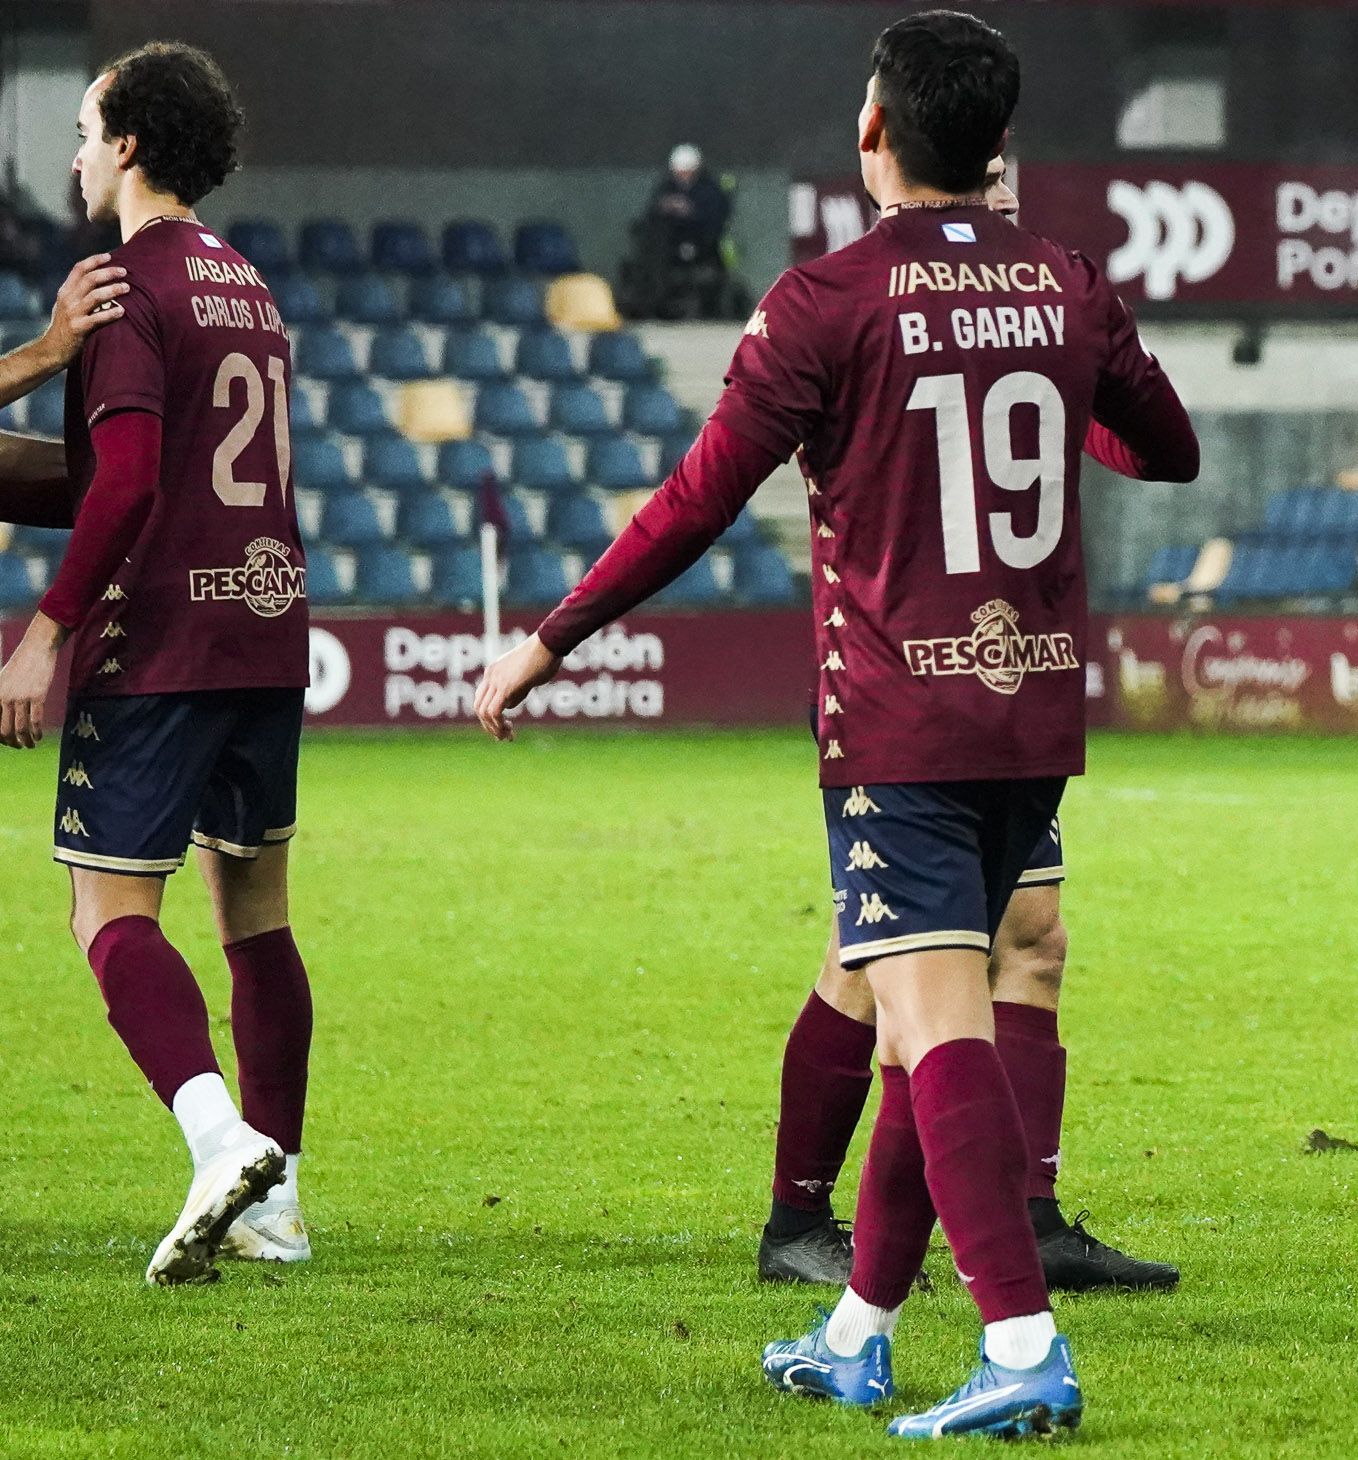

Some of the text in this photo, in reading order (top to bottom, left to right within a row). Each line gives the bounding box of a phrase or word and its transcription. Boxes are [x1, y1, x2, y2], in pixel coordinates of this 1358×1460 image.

[195, 257, 268, 290] ABANC
[191, 295, 254, 330] CARLOS
[898, 305, 1065, 355] B. GARAY
[212, 352, 291, 509] 21
[906, 371, 1066, 575] 19
[244, 536, 291, 557] CONSERVAS
[189, 566, 307, 601] PESCAM
